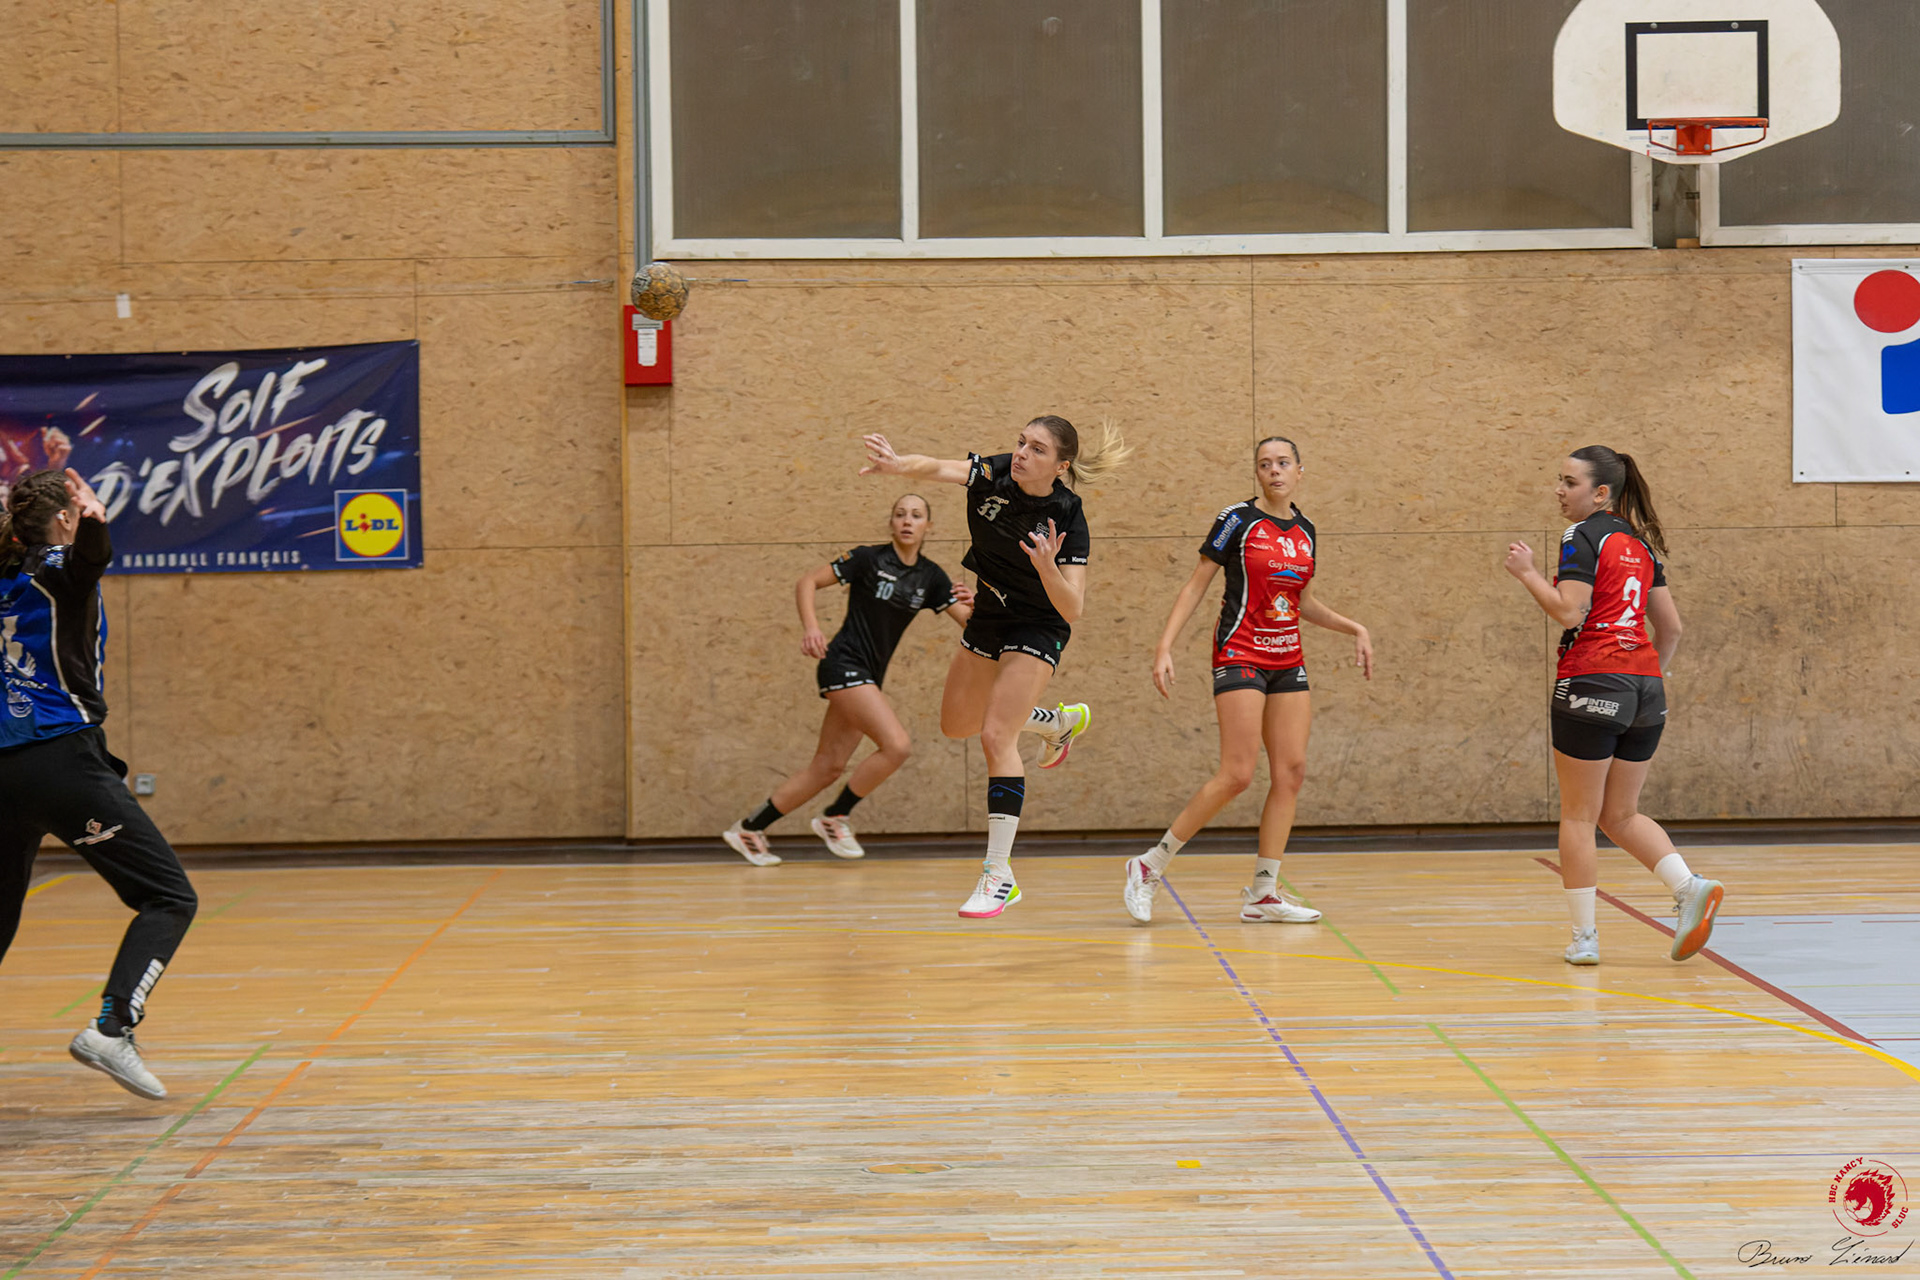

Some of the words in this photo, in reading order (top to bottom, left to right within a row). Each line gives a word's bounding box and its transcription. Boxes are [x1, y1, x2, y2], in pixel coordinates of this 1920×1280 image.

[976, 502, 1002, 522] 33
[1276, 536, 1297, 558] 18
[122, 552, 208, 568] HANDBALL
[216, 549, 301, 569] FRANÇAIS
[1267, 559, 1283, 570] Guy
[875, 580, 895, 601] 10
[1614, 575, 1642, 627] 2
[1022, 644, 1042, 656] Kempa
[1586, 705, 1619, 717] SPORT
[1588, 697, 1620, 710] INTER
